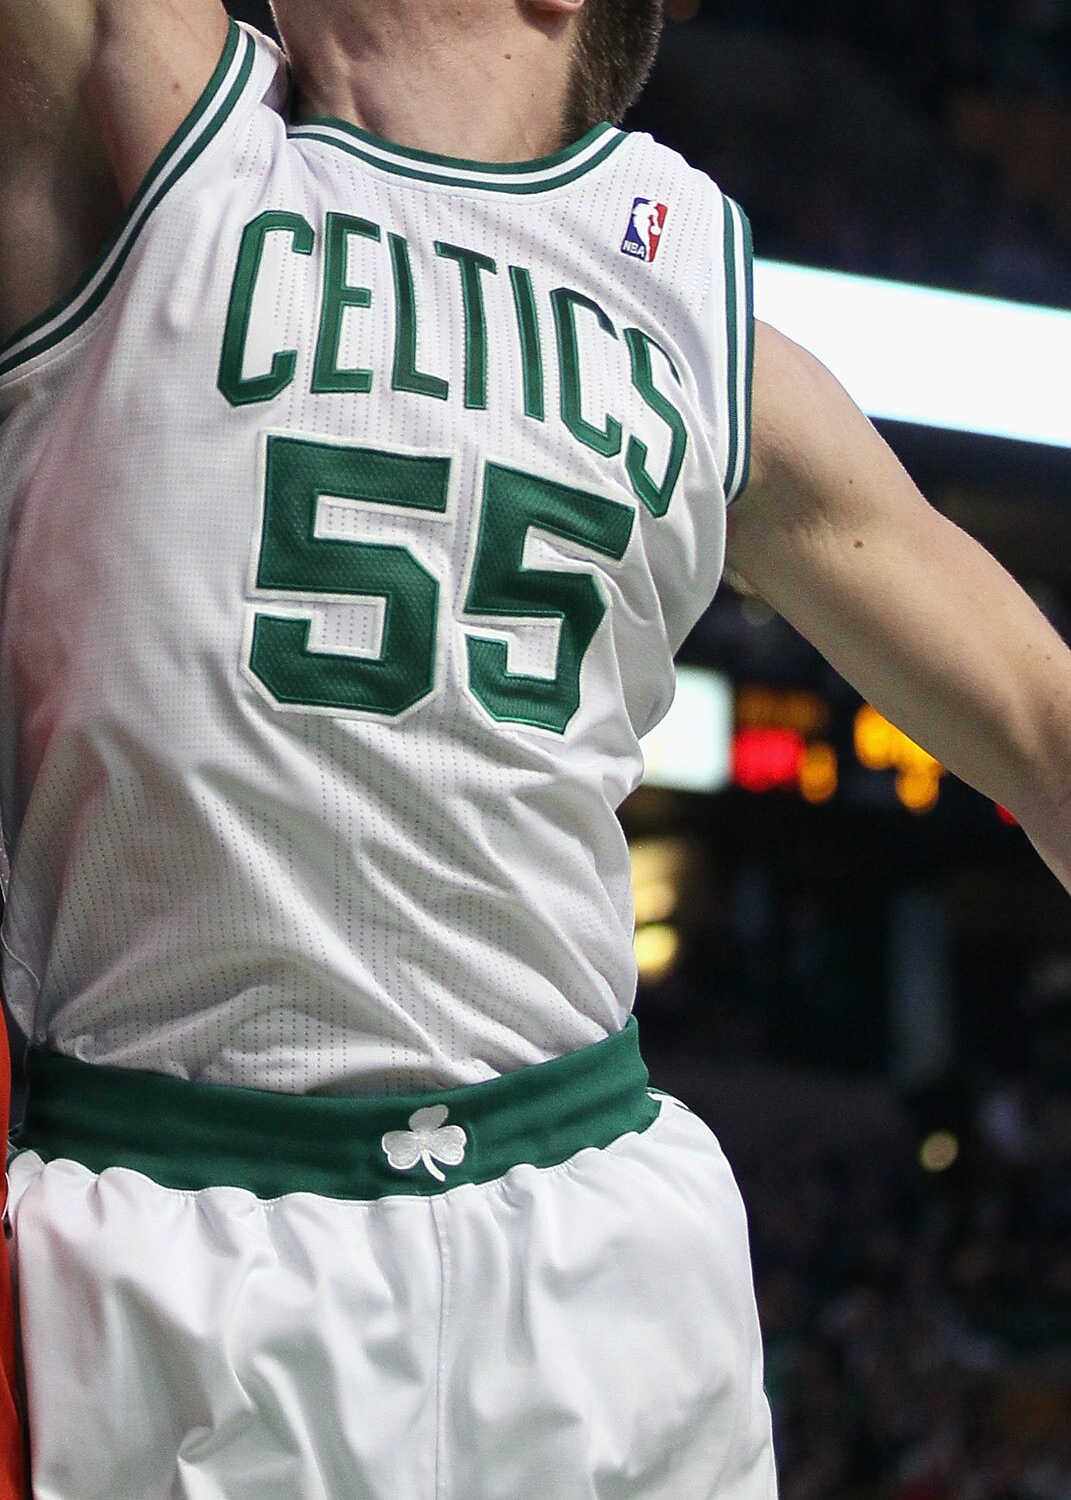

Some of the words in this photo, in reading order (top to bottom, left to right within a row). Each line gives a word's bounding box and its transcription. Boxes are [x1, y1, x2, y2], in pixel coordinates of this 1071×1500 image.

[217, 210, 687, 518] CELTICS
[622, 240, 646, 258] NBA
[245, 432, 638, 739] 55
